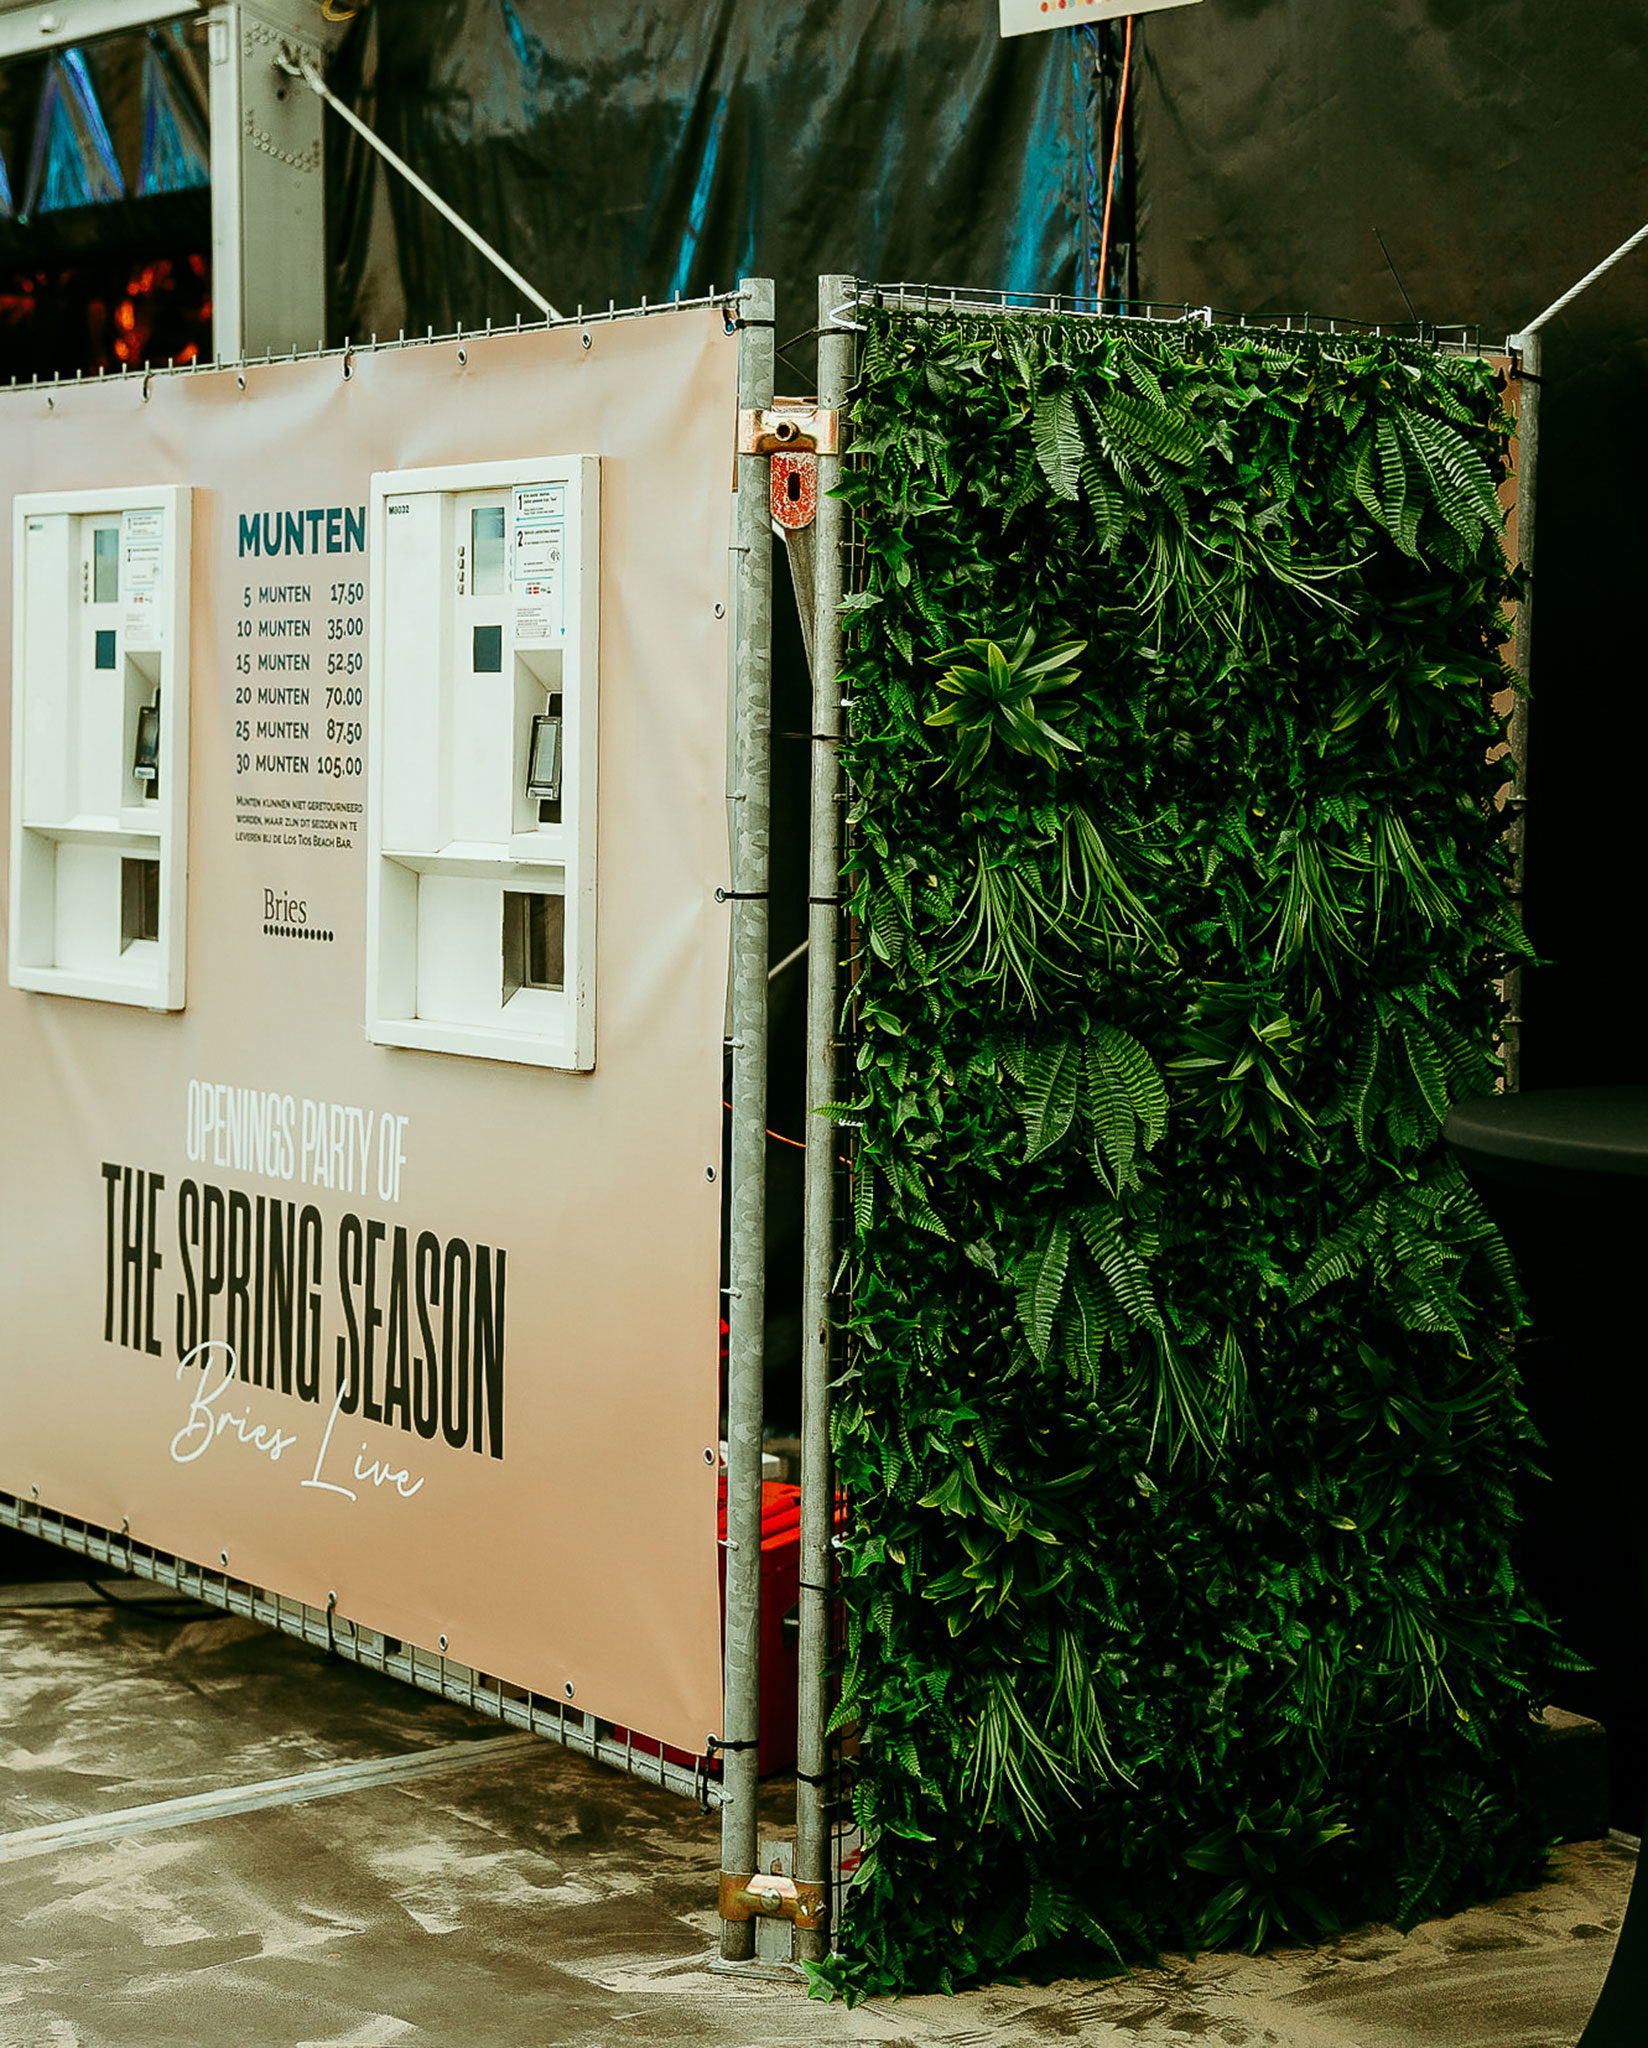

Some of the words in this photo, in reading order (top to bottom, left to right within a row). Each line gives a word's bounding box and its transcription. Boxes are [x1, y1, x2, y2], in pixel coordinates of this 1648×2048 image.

[239, 506, 366, 558] MUNTEN
[244, 586, 251, 608] 5
[258, 585, 311, 603] MUNTEN
[330, 582, 364, 605] 17.50
[236, 619, 252, 638] 10
[258, 619, 311, 637] MUNTEN
[327, 617, 364, 640] 35.00
[236, 653, 251, 675] 15
[257, 653, 310, 672] MUNTEN
[327, 652, 363, 675] 52.50
[235, 687, 252, 704] 20
[257, 687, 310, 705] MUNTEN
[325, 687, 363, 709] 70.00
[235, 720, 250, 742] 25
[256, 721, 310, 739] MUNTEN
[326, 718, 363, 745] 87.50
[235, 753, 250, 775] 30
[255, 754, 310, 774] MUNTEN
[317, 756, 363, 779] 105.00
[236, 795, 261, 807] MUNTEN
[262, 798, 291, 809] KUNNEN
[292, 799, 306, 810] NIET
[307, 800, 363, 813] GERETOURNEERD
[264, 816, 283, 826] MAAR
[300, 818, 310, 828] DIT
[311, 819, 338, 830] SEIZOEN
[340, 820, 347, 830] IN
[349, 821, 358, 831] TE
[235, 832, 261, 842] LEVEREN
[273, 834, 282, 844] DE
[283, 833, 297, 845] LOS
[313, 834, 335, 848] BEACH
[263, 887, 307, 924] Bries
[187, 1079, 295, 1181] OPENINGS
[302, 1099, 374, 1197] PARTY
[378, 1112, 409, 1203] OF
[102, 1162, 165, 1358] THE
[176, 1178, 322, 1404] SPRING
[336, 1213, 507, 1461] SEASON
[170, 1341, 297, 1463] Bries
[301, 1378, 424, 1501] Live
